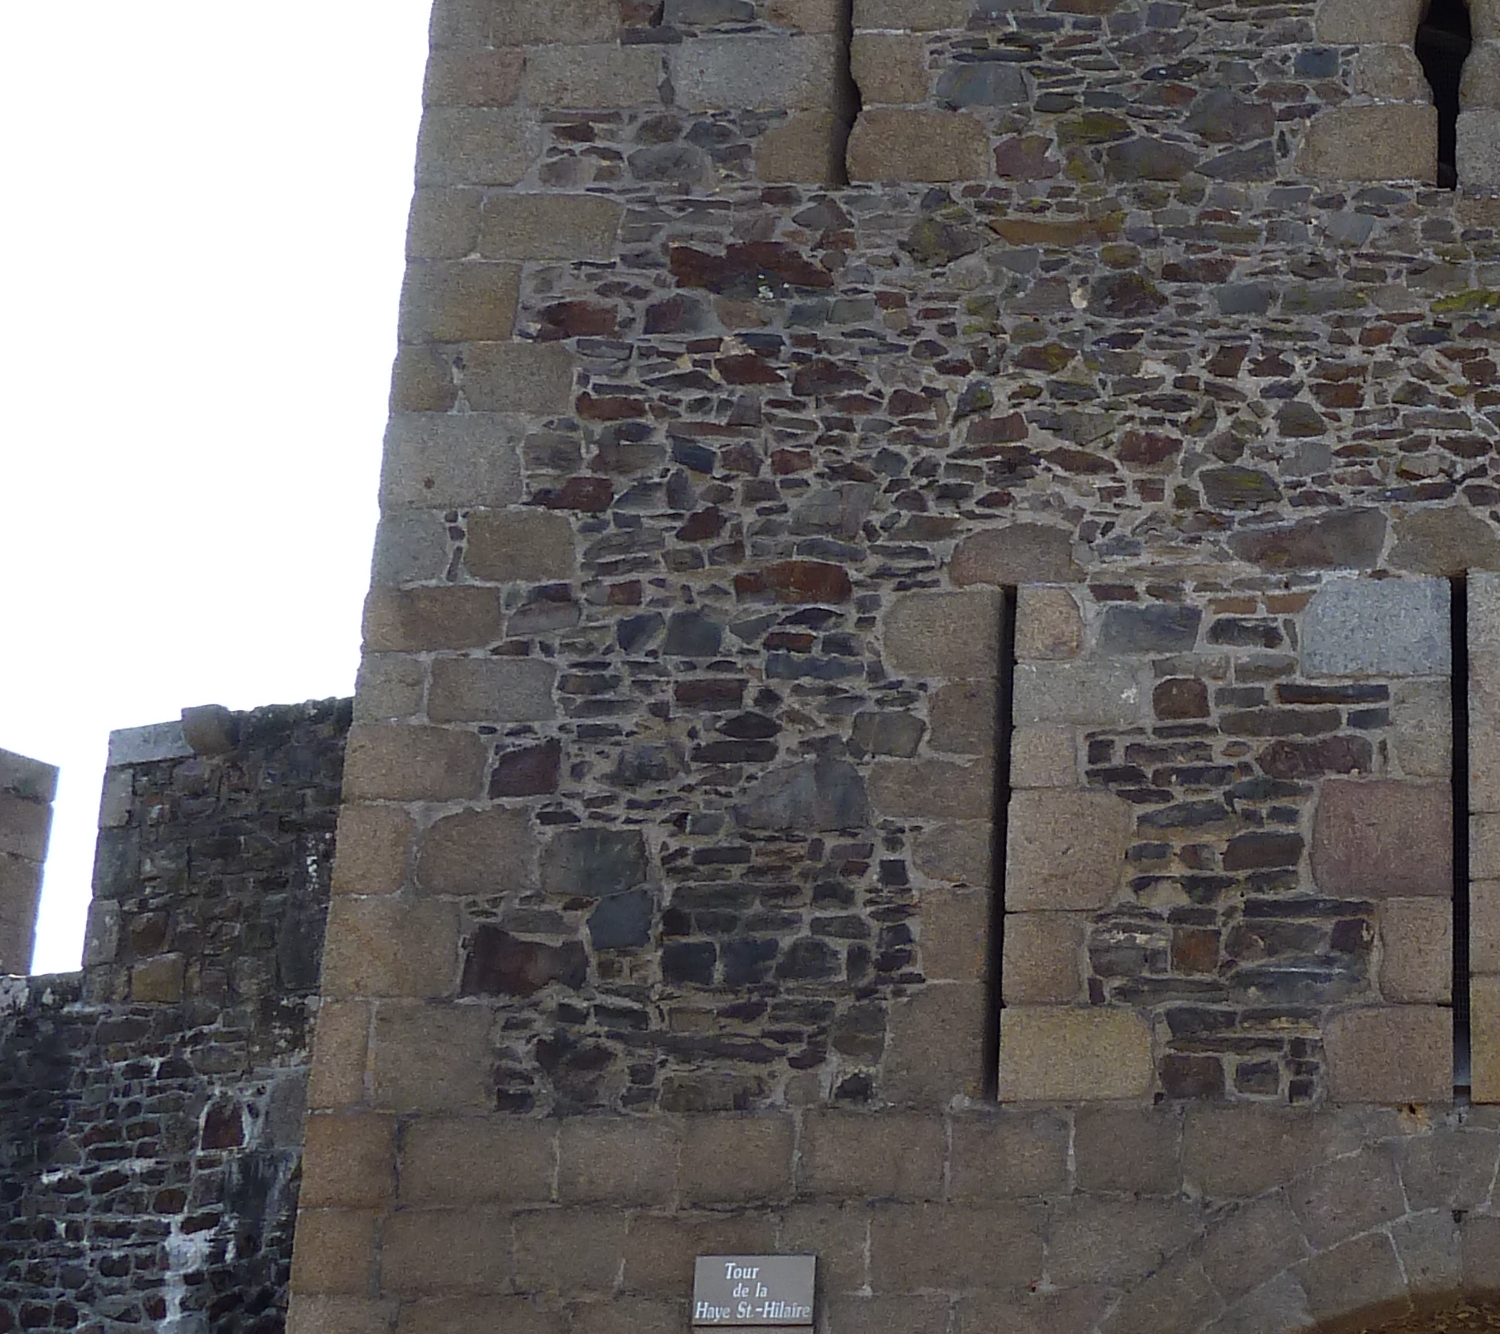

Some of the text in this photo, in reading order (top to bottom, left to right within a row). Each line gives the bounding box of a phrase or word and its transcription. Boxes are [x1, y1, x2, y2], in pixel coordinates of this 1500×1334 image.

[725, 1262, 759, 1280] Tour
[733, 1282, 768, 1298] de la
[695, 1301, 730, 1322] Haye
